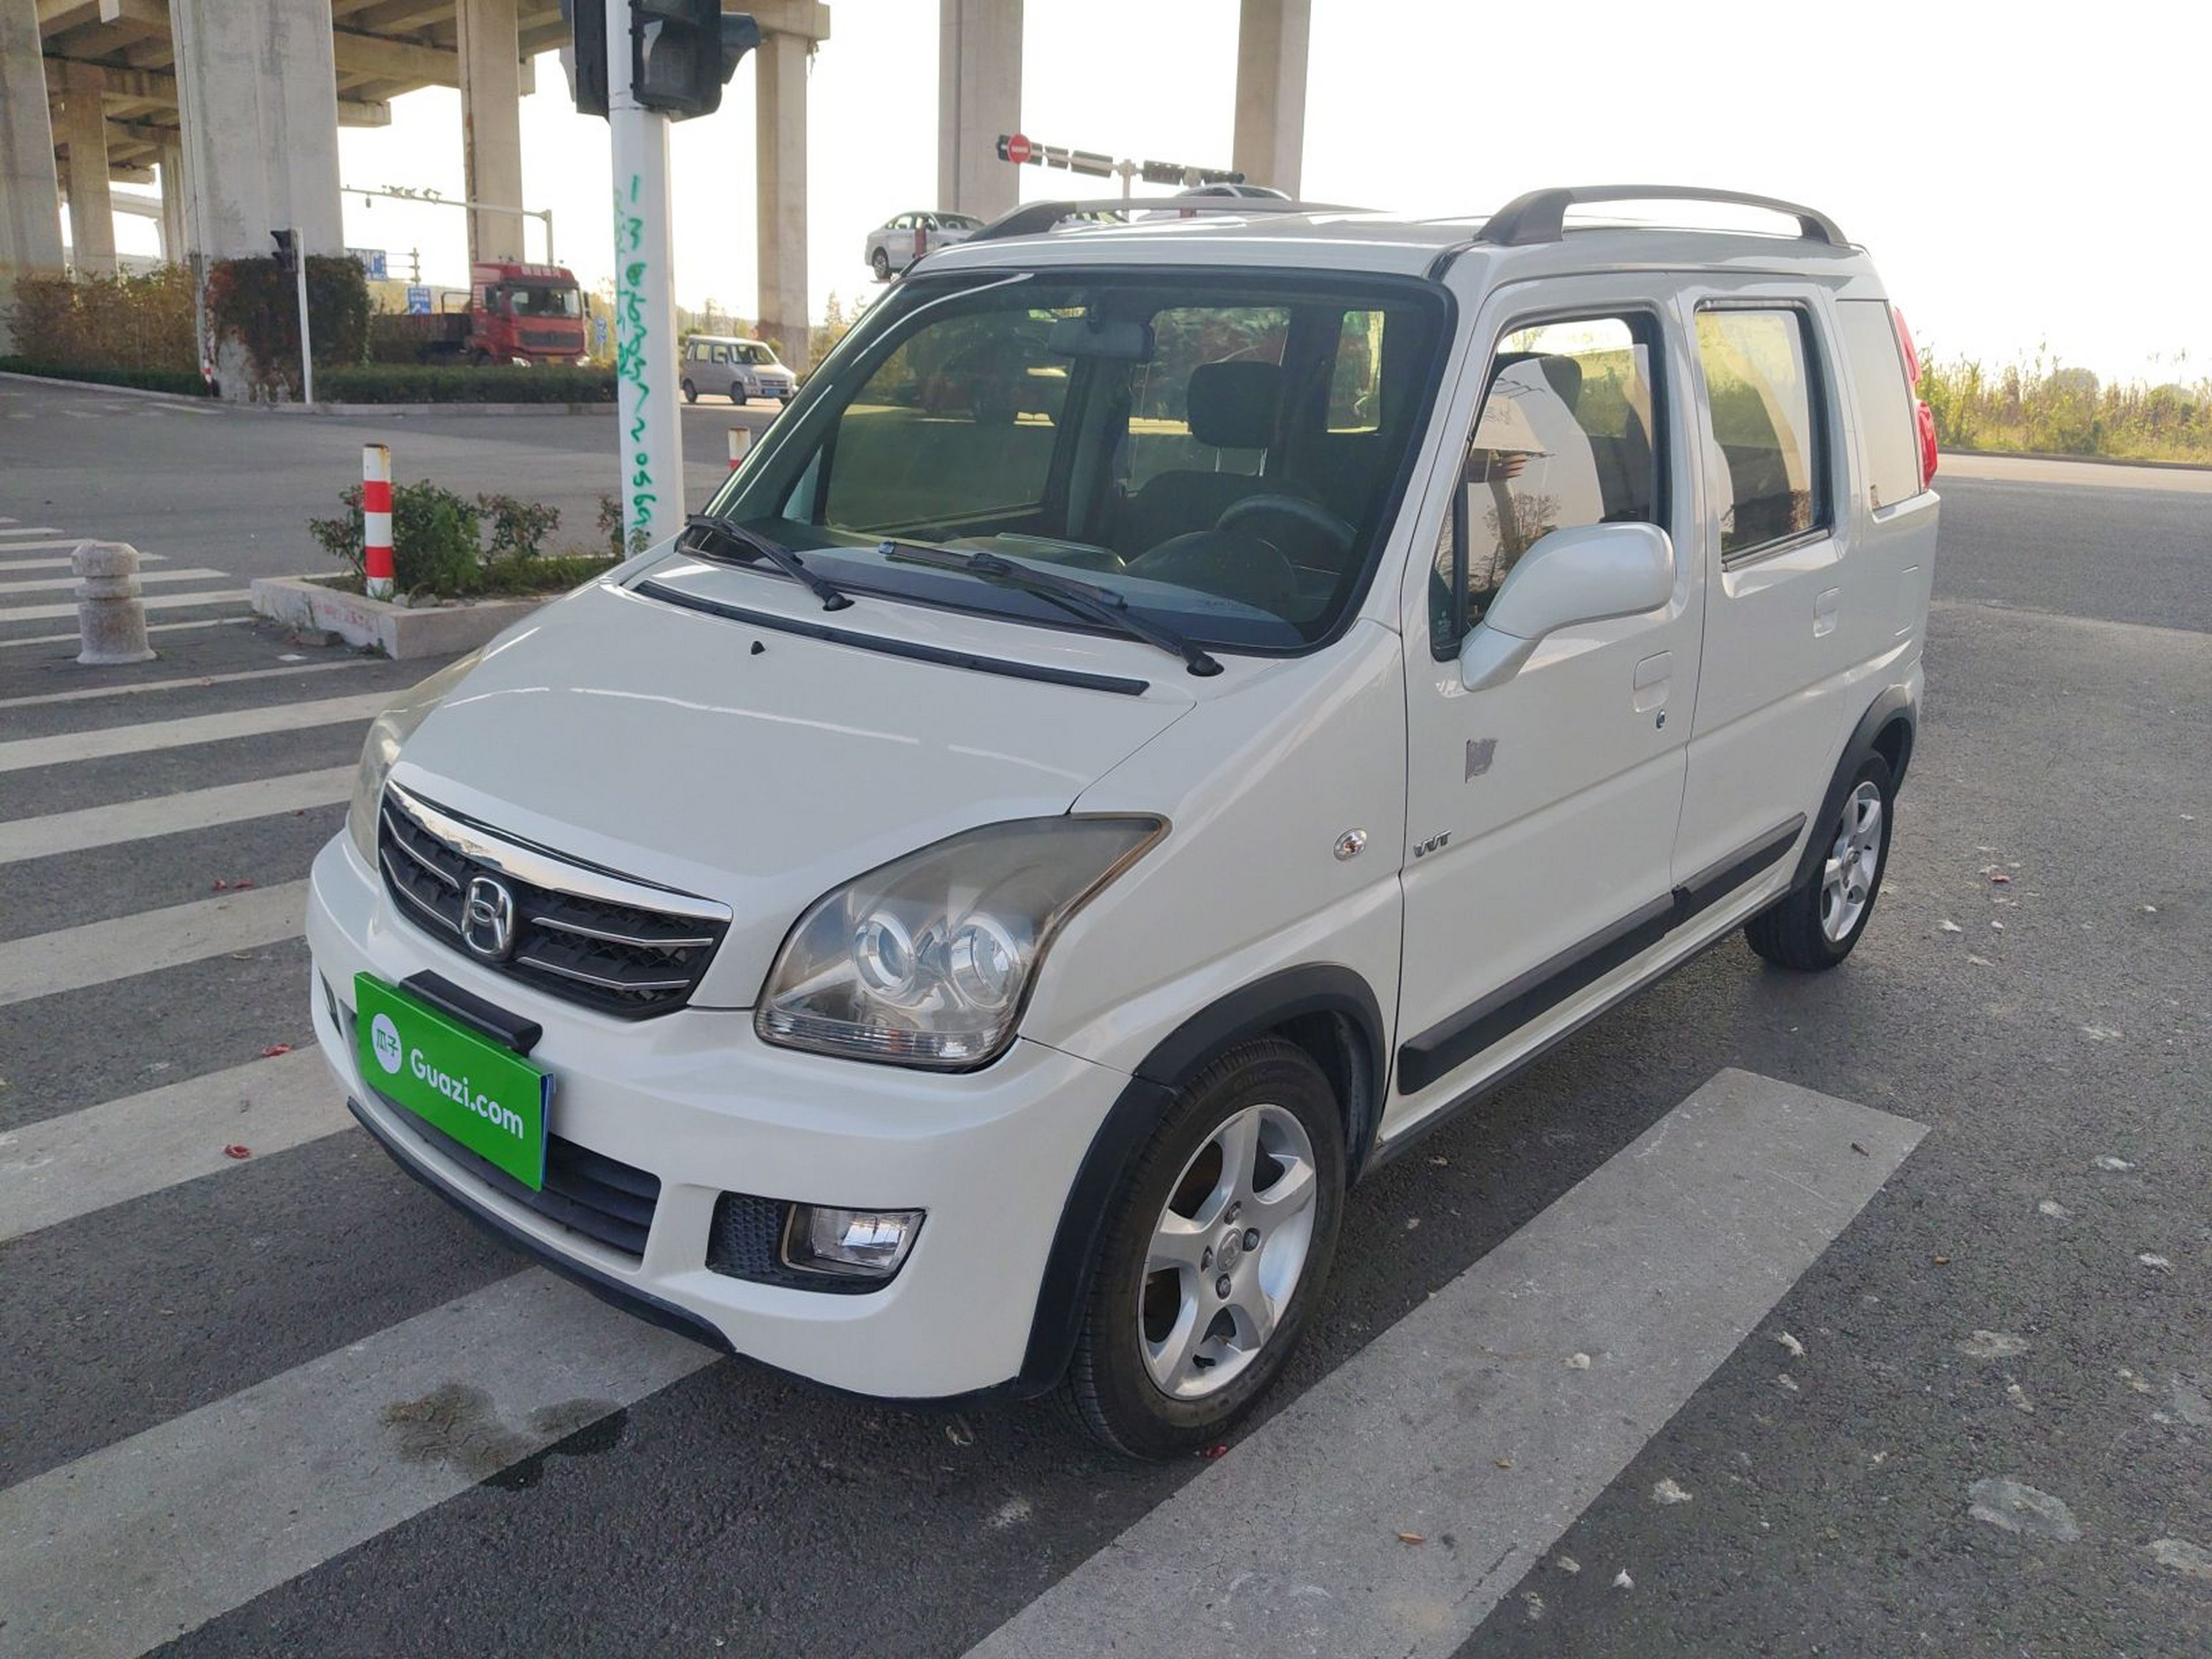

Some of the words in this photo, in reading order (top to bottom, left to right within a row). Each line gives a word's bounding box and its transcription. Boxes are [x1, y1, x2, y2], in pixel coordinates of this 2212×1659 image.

[1414, 830, 1452, 858] VVT
[376, 1028, 399, 1058] 瓜子
[410, 1048, 524, 1139] Guazi.com
